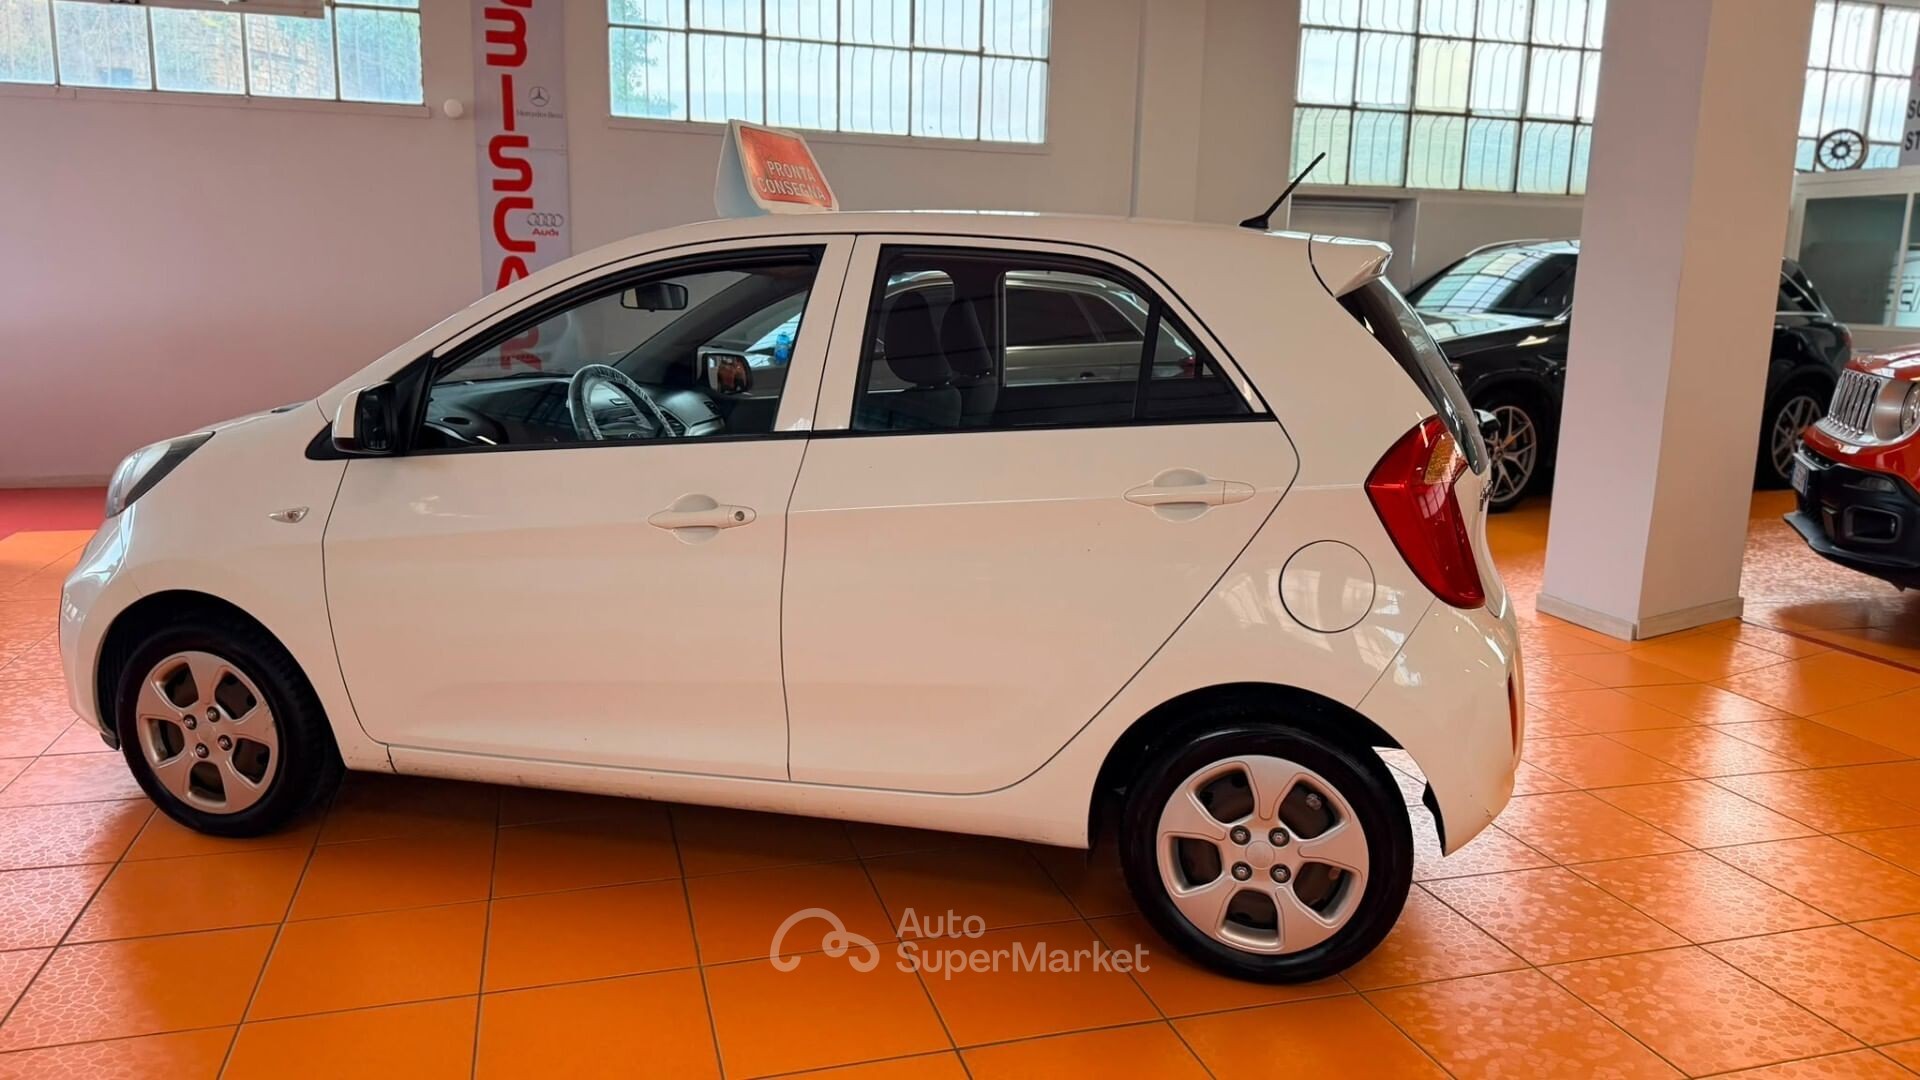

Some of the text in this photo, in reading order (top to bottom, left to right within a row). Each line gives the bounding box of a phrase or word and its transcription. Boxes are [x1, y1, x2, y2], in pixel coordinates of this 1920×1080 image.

[766, 160, 817, 183] PRONTA
[756, 176, 826, 201] CONSEGNA
[532, 227, 560, 237] Audi
